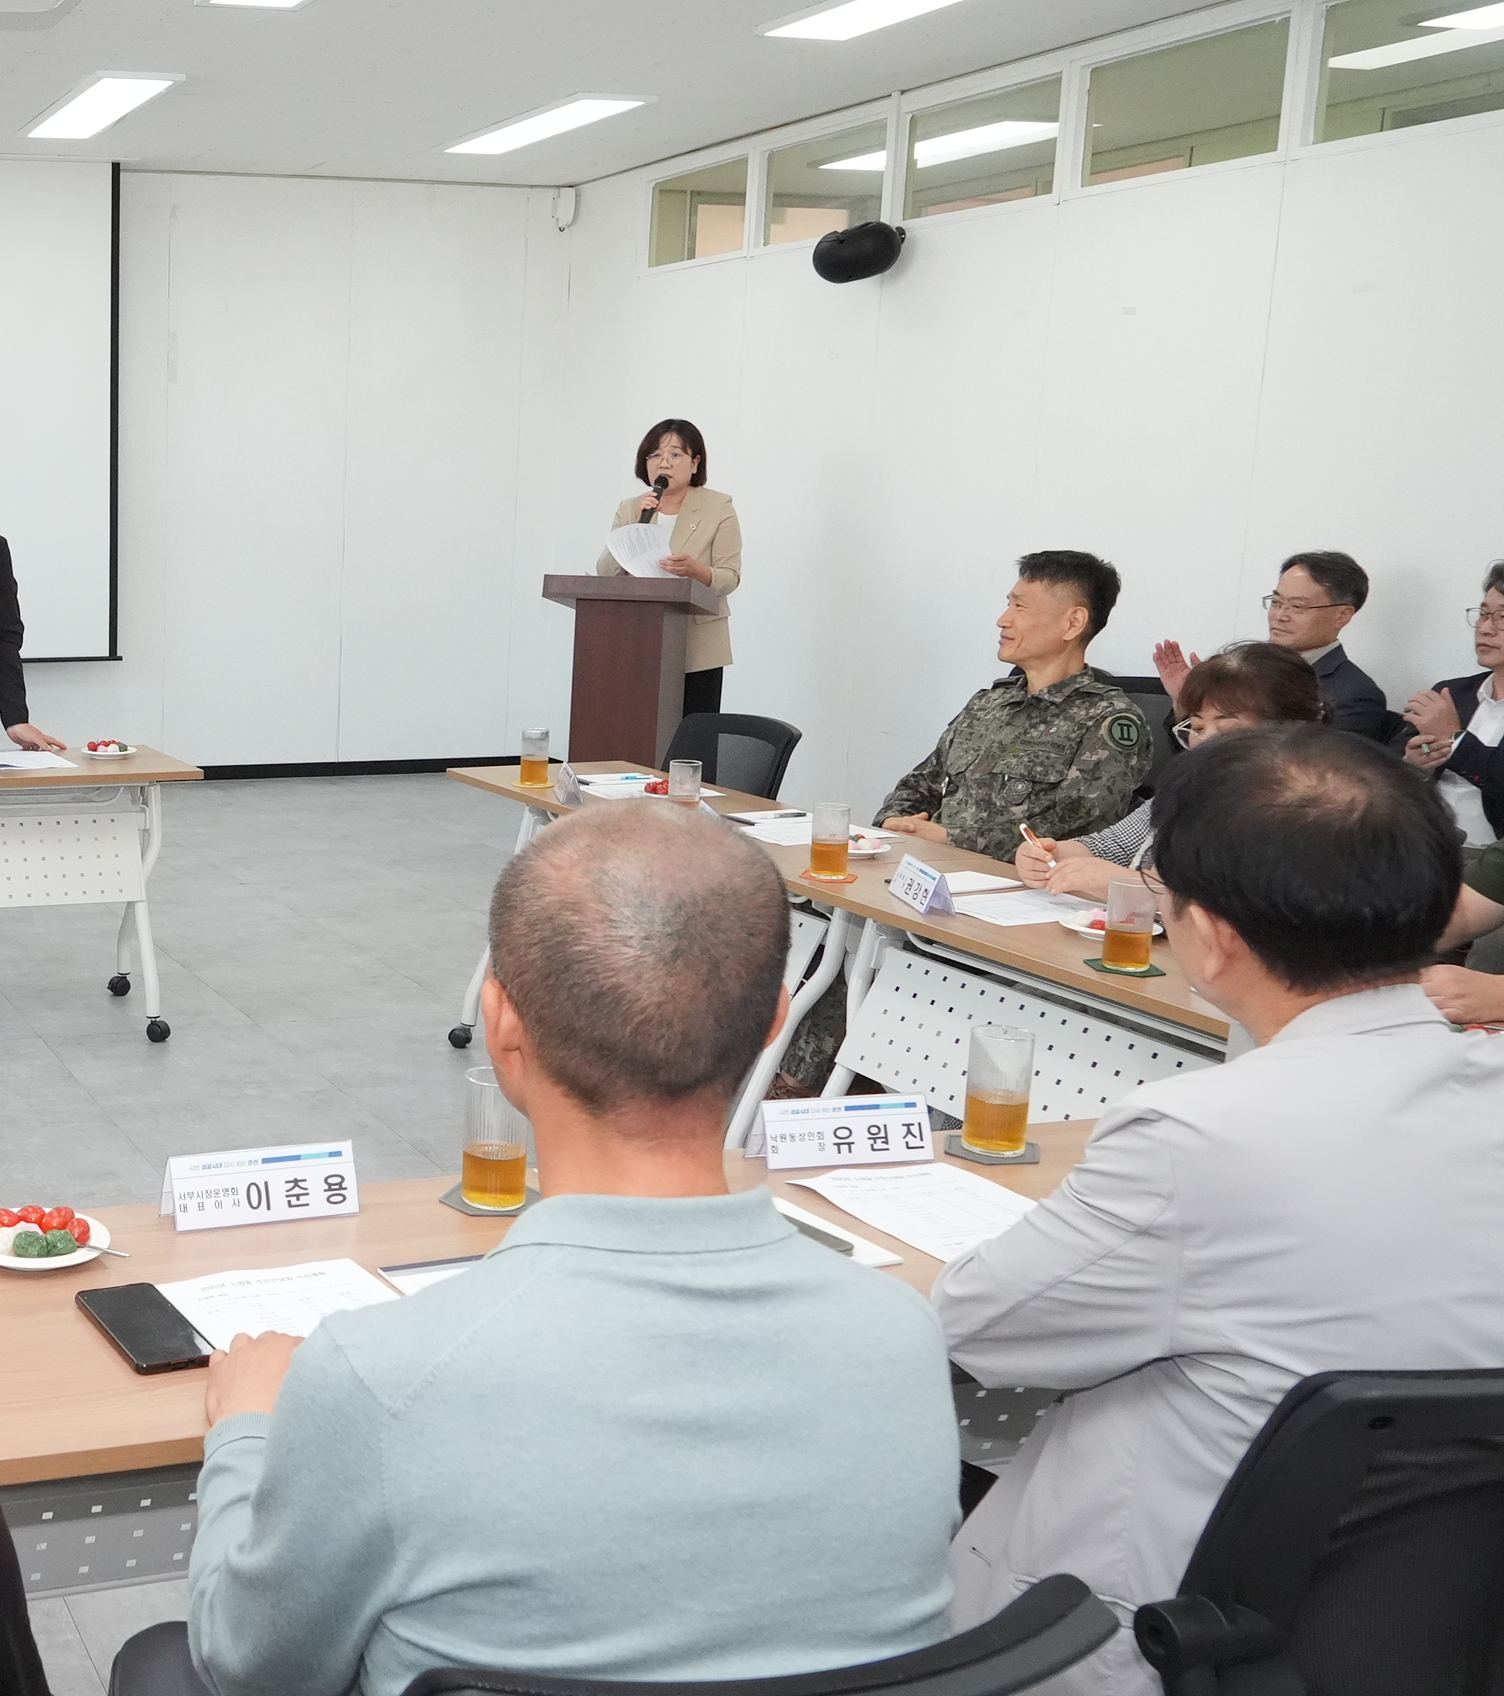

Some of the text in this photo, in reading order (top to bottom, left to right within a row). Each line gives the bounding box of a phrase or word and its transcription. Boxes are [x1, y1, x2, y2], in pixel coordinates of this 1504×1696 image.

[769, 1131, 825, 1143] 낙원동상인회
[832, 1121, 926, 1155] 유원진
[178, 1186, 239, 1202] 서부시장운영회
[246, 1173, 348, 1211] 이춘용
